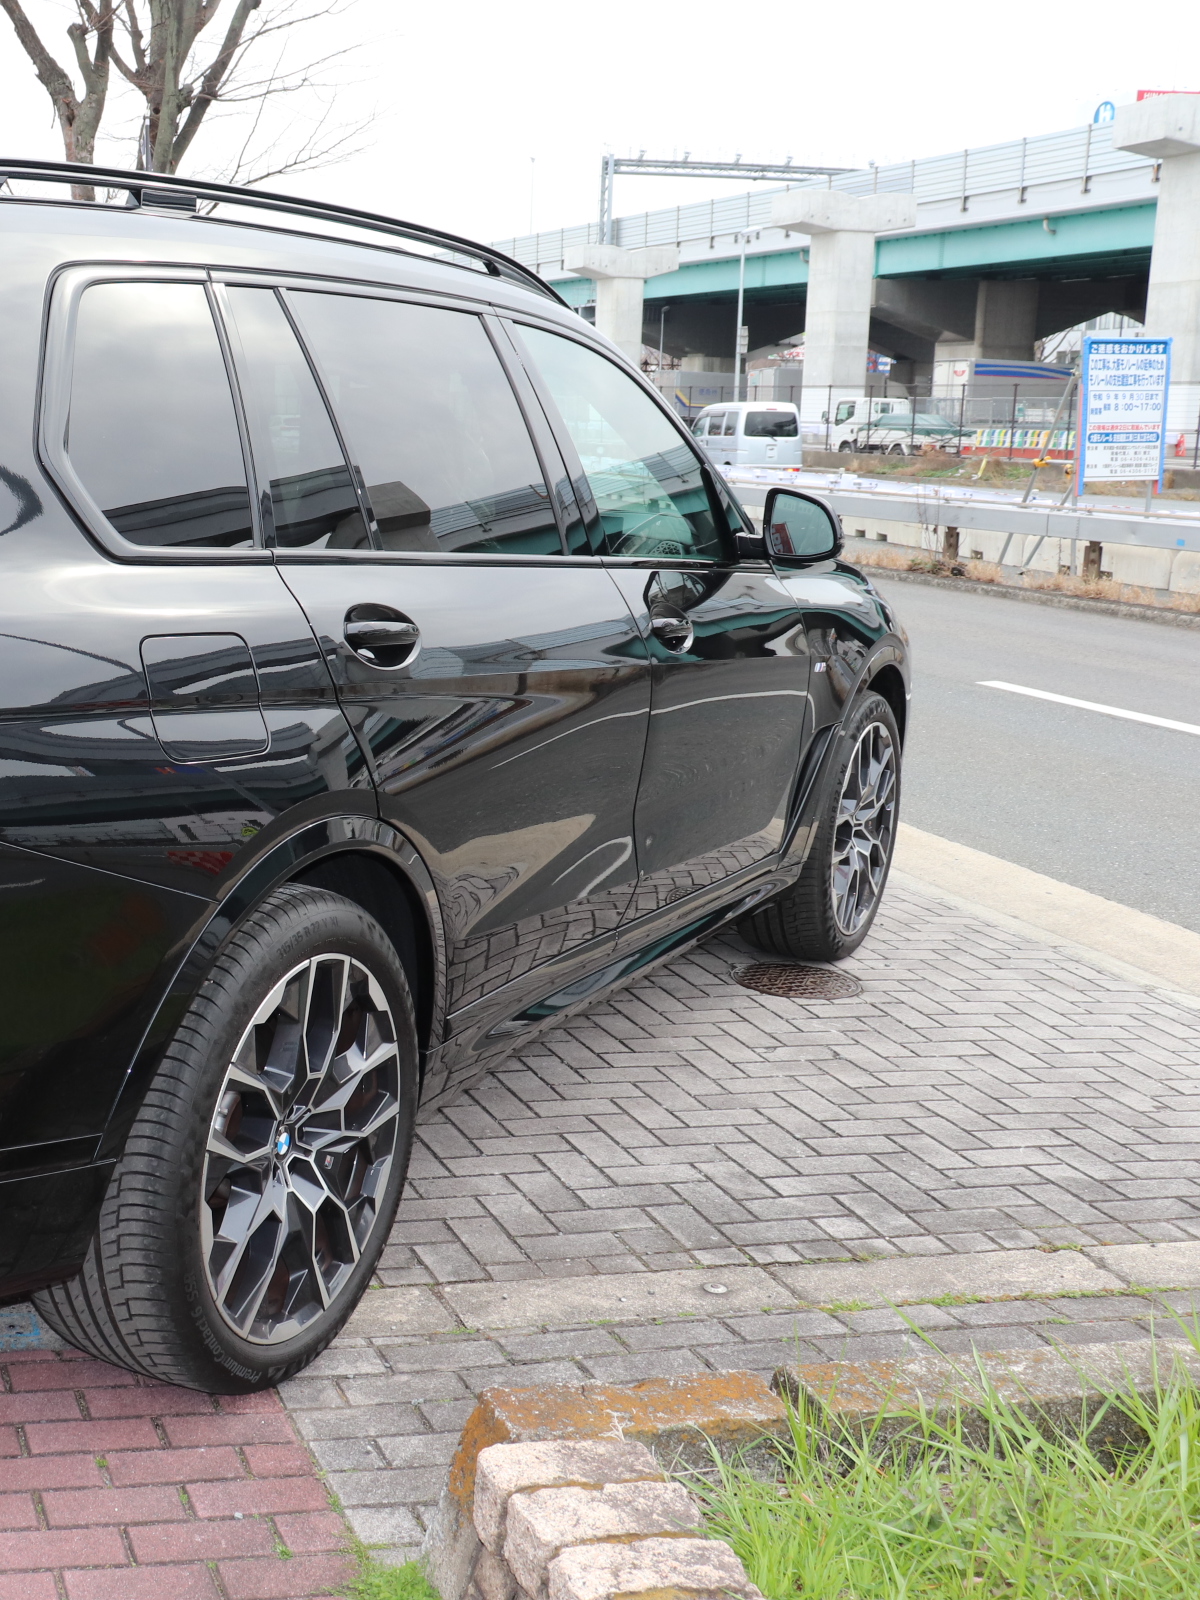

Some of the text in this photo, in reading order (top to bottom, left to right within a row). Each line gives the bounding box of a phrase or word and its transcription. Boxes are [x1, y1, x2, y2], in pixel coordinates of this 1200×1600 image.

[1091, 344, 1166, 354] ご迷惑をおかけします
